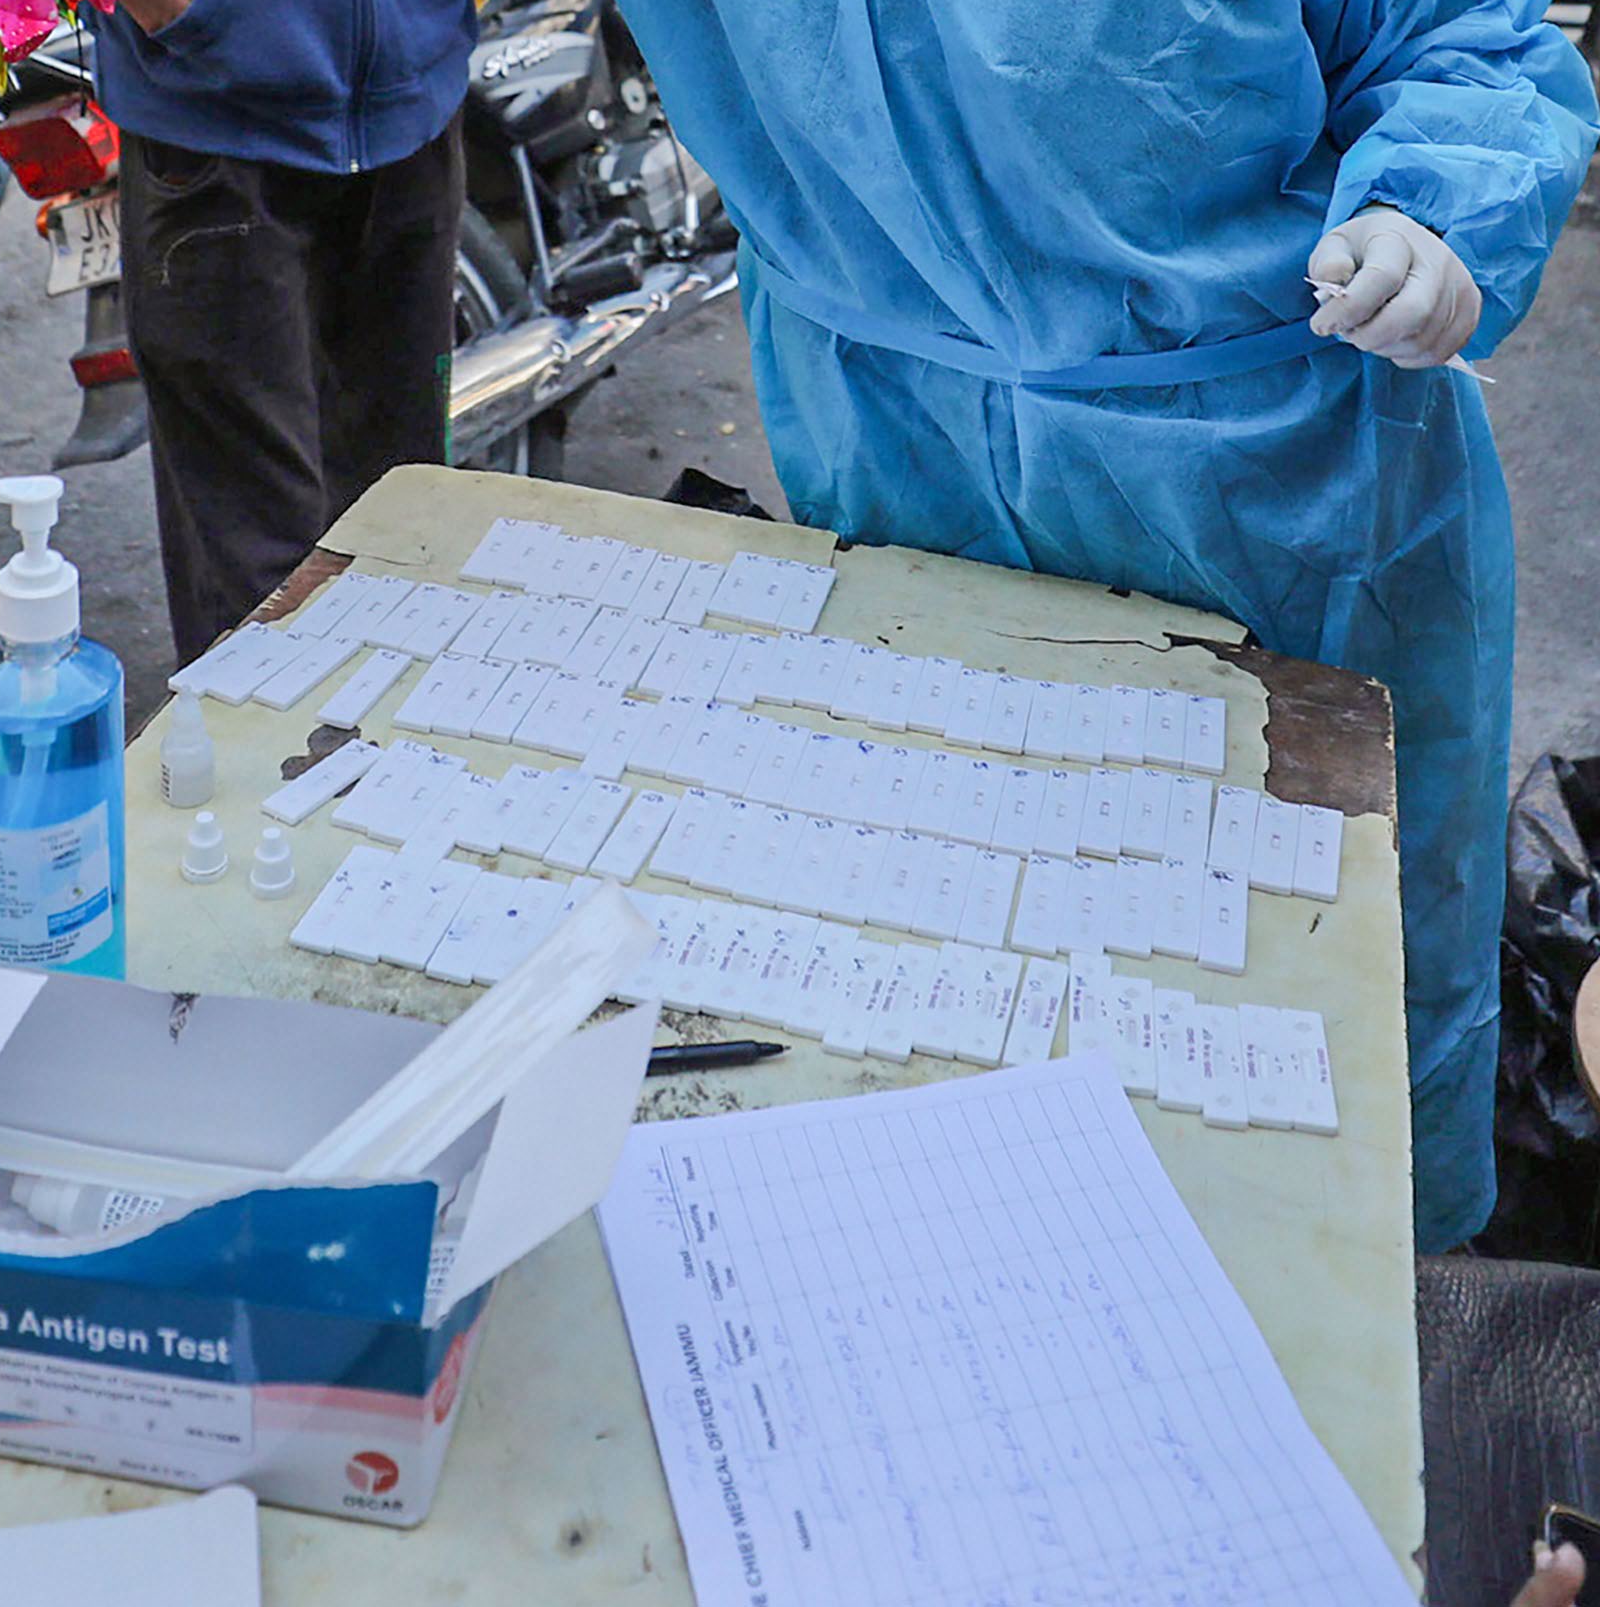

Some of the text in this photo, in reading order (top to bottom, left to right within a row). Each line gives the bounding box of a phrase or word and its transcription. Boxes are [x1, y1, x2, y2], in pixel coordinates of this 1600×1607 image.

[680, 1250, 695, 1280] Dated
[705, 1260, 723, 1302] Collection
[17, 1308, 149, 1353] Antigen
[157, 1327, 232, 1366] Test
[675, 1322, 705, 1383] JAMMU
[693, 1388, 724, 1451] OFFICER
[342, 1494, 404, 1514] OSCAR
[714, 1454, 746, 1528] MEDICAL
[735, 1530, 763, 1589] CHIEF
